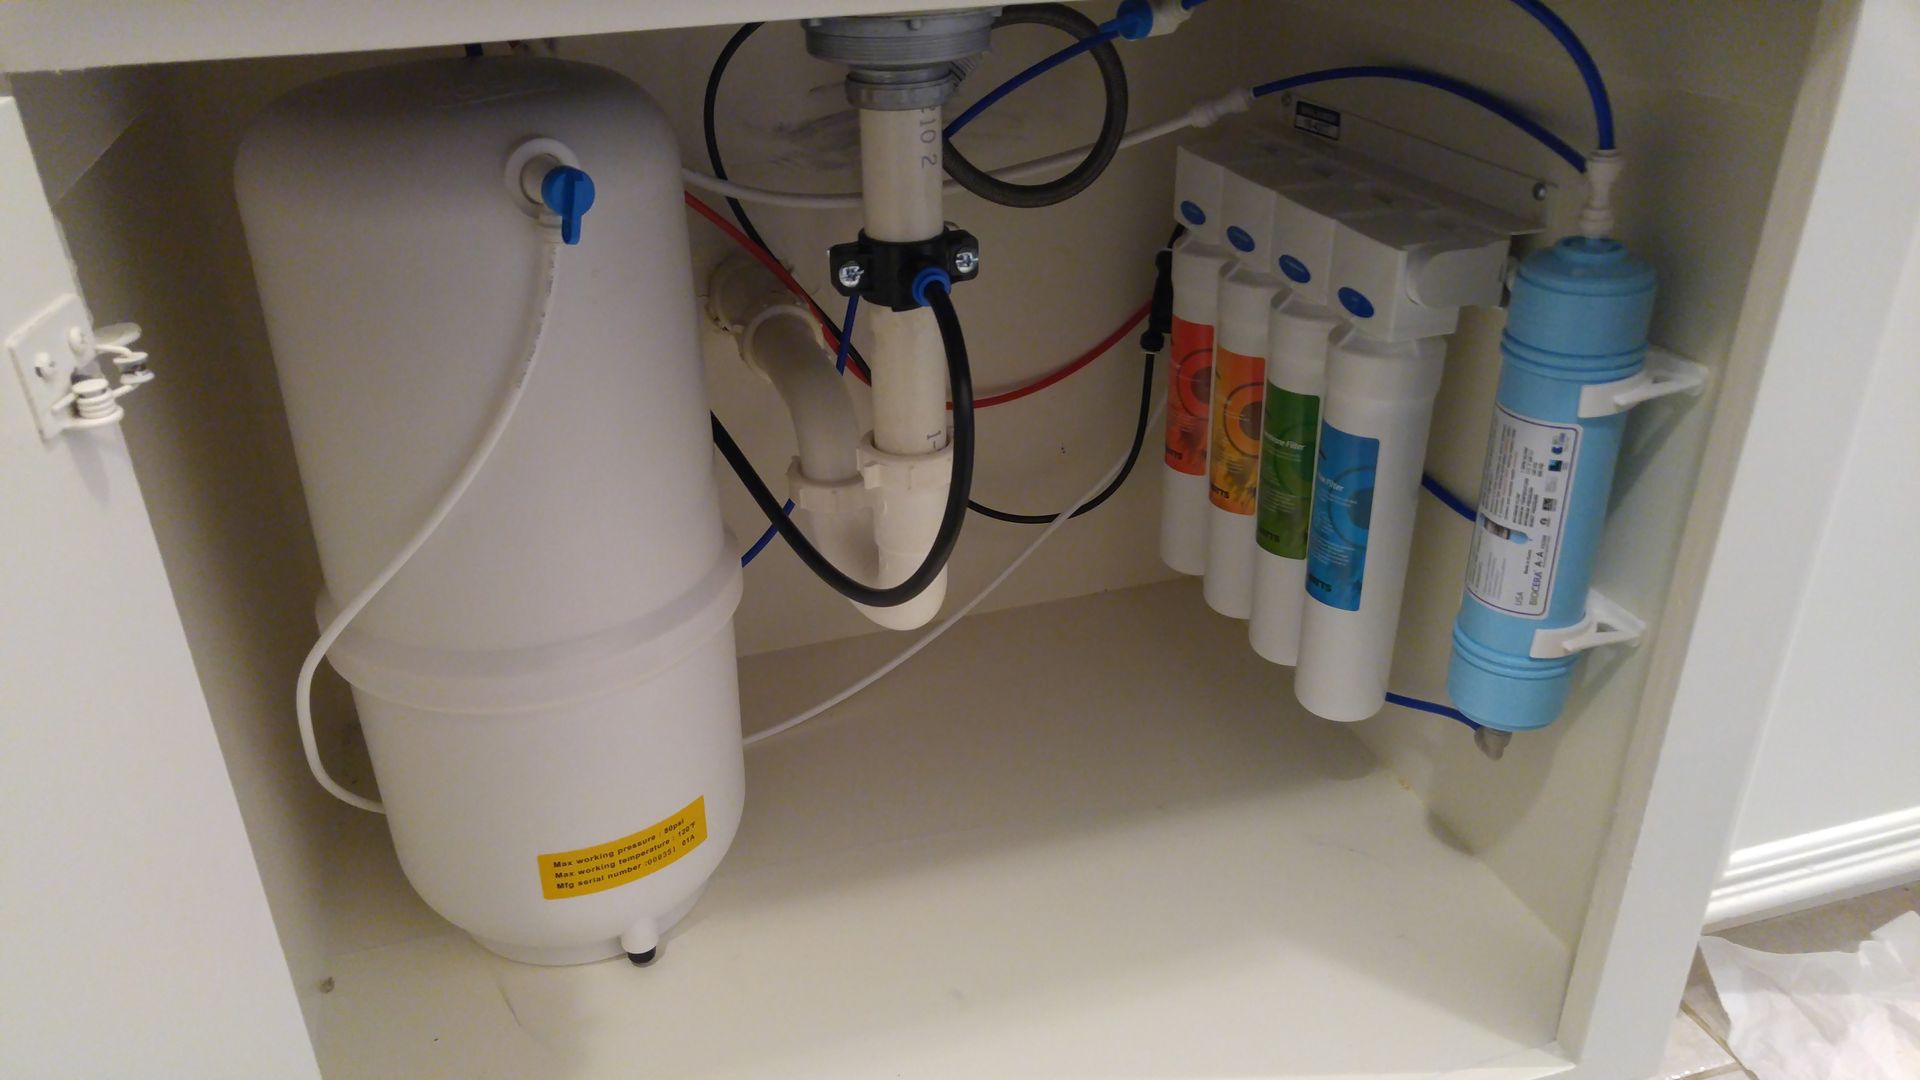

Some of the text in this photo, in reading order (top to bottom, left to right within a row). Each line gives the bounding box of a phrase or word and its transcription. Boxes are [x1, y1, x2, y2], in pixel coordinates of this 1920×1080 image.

[1529, 571, 1544, 606] BIOCERA
[552, 860, 573, 868] Max
[576, 850, 614, 864] working
[617, 834, 656, 854] pressure
[554, 870, 574, 879] Max
[578, 861, 616, 875] working
[618, 838, 671, 865] temperature
[556, 881, 575, 890] Mfg
[578, 875, 604, 887] serial
[607, 863, 642, 880] number
